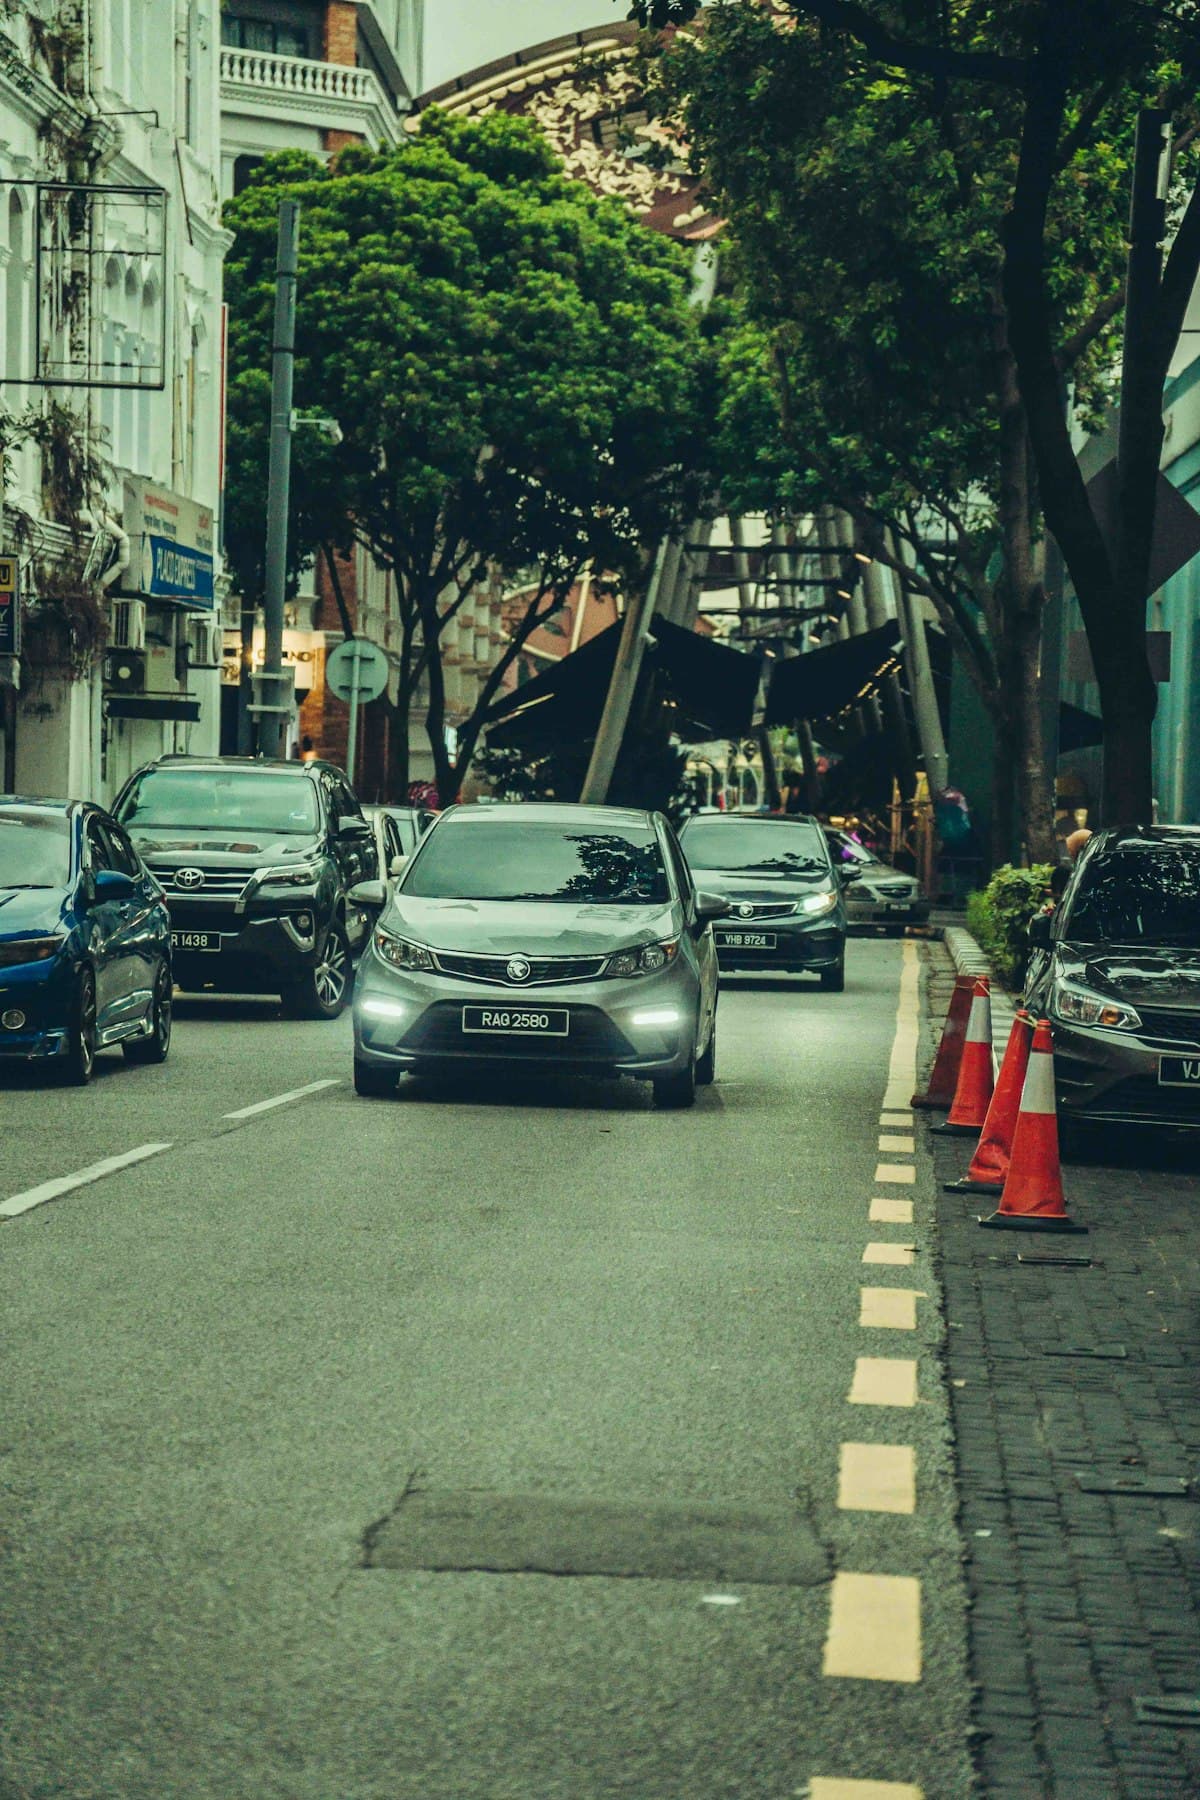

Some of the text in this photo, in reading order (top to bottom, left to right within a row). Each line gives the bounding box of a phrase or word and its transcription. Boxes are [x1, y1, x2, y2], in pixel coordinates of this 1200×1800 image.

[182, 934, 208, 947] 1438
[725, 935, 766, 945] VHB 9724
[512, 1013, 549, 1028] 2580
